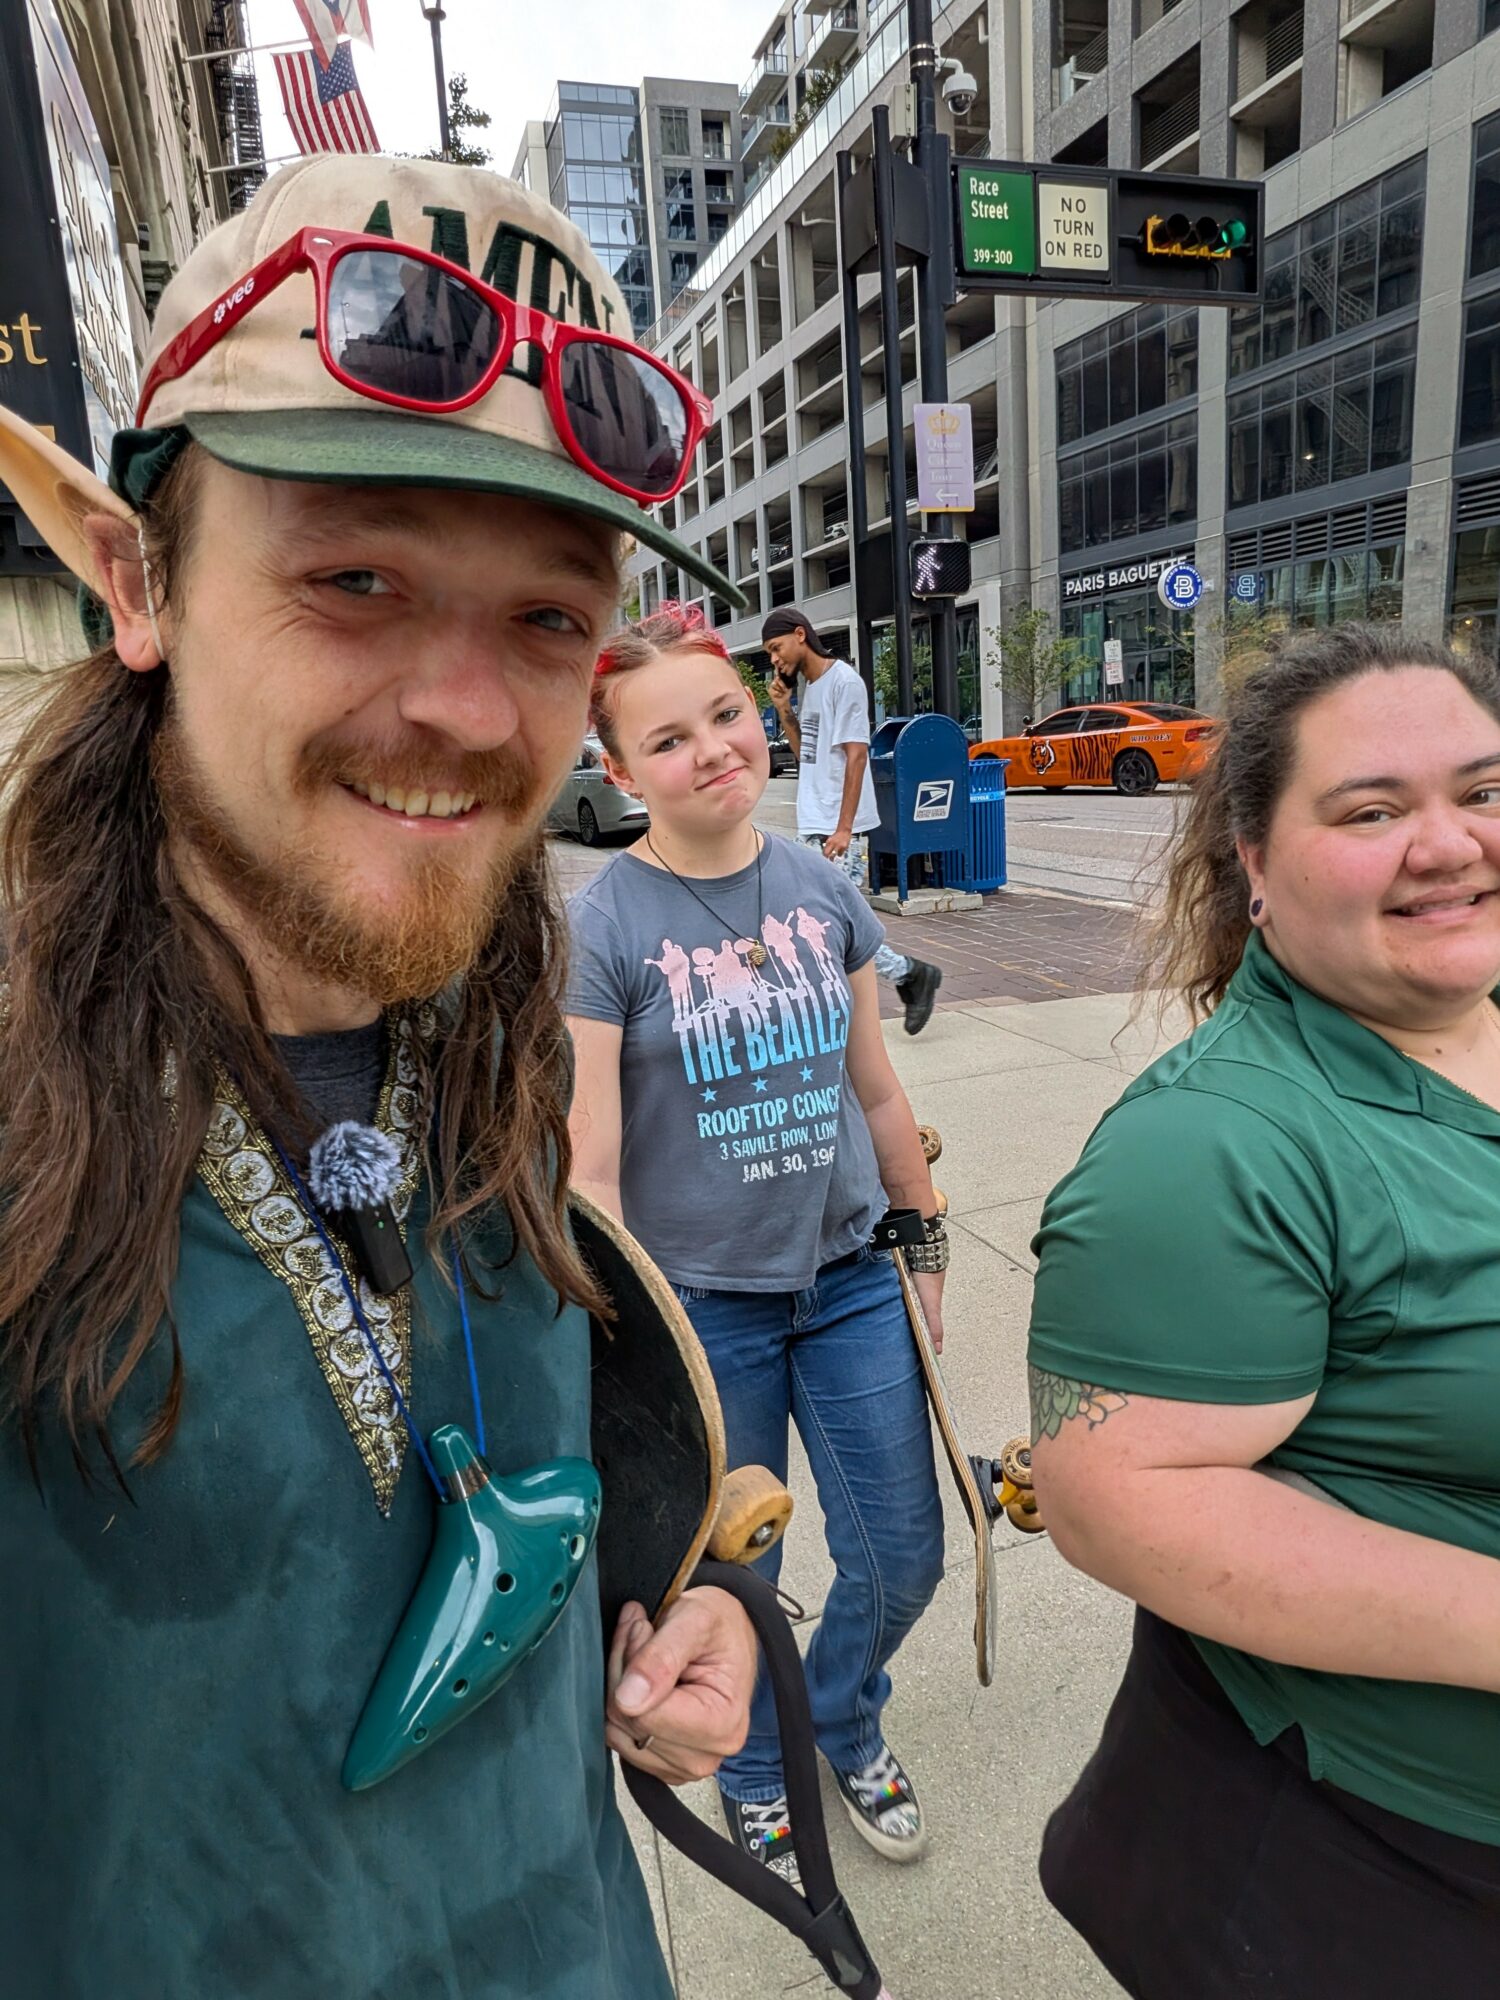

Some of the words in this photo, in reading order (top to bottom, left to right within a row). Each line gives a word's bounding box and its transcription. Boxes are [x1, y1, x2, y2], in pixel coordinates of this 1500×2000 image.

[969, 177, 999, 197] Race
[971, 200, 1009, 220] Street
[1060, 197, 1087, 214] NO
[1053, 219, 1095, 236] TURN
[973, 249, 1013, 265] 399-300
[1045, 241, 1066, 257] ON
[1073, 243, 1103, 259] RED
[1066, 574, 1105, 596] PARIS
[1174, 575, 1194, 598] B
[1130, 734, 1150, 743] WHO
[672, 1004, 742, 1085] THE
[697, 1097, 788, 1138] ROOFTOP
[719, 1142, 729, 1161] 3
[733, 1134, 778, 1160] SAVILE
[781, 1126, 813, 1147] ROW,
[742, 1158, 778, 1183] JAN.
[781, 1153, 807, 1174] 30,
